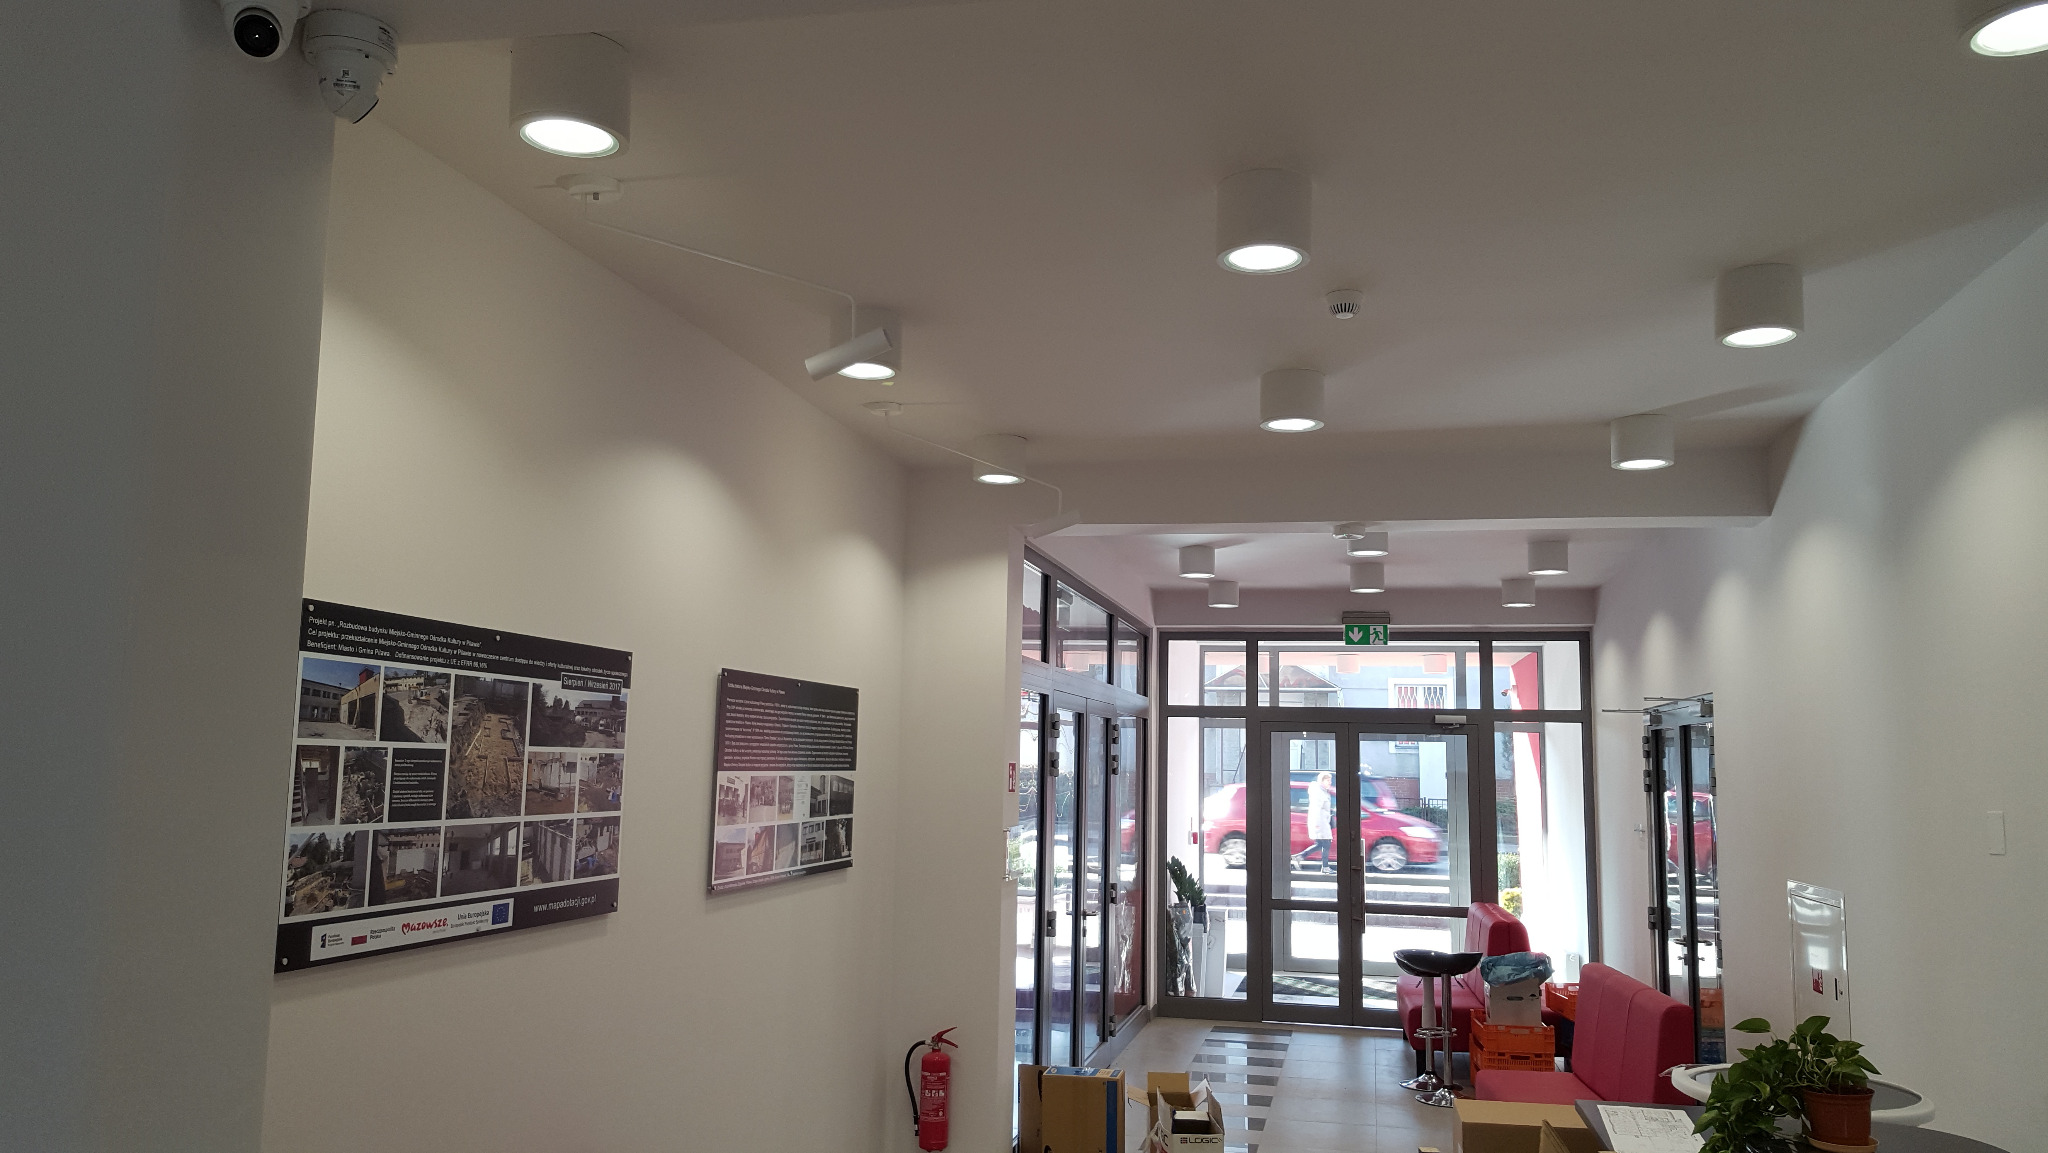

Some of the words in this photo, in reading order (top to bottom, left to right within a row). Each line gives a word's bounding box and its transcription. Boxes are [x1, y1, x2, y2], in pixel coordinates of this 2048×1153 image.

[309, 616, 327, 625] Projekt
[308, 628, 317, 636] Cel
[337, 643, 355, 653] Miasto
[359, 646, 374, 654] Gmina
[563, 676, 584, 688] Sierpień
[587, 679, 609, 689] Wrzesień
[609, 682, 621, 691] 2017
